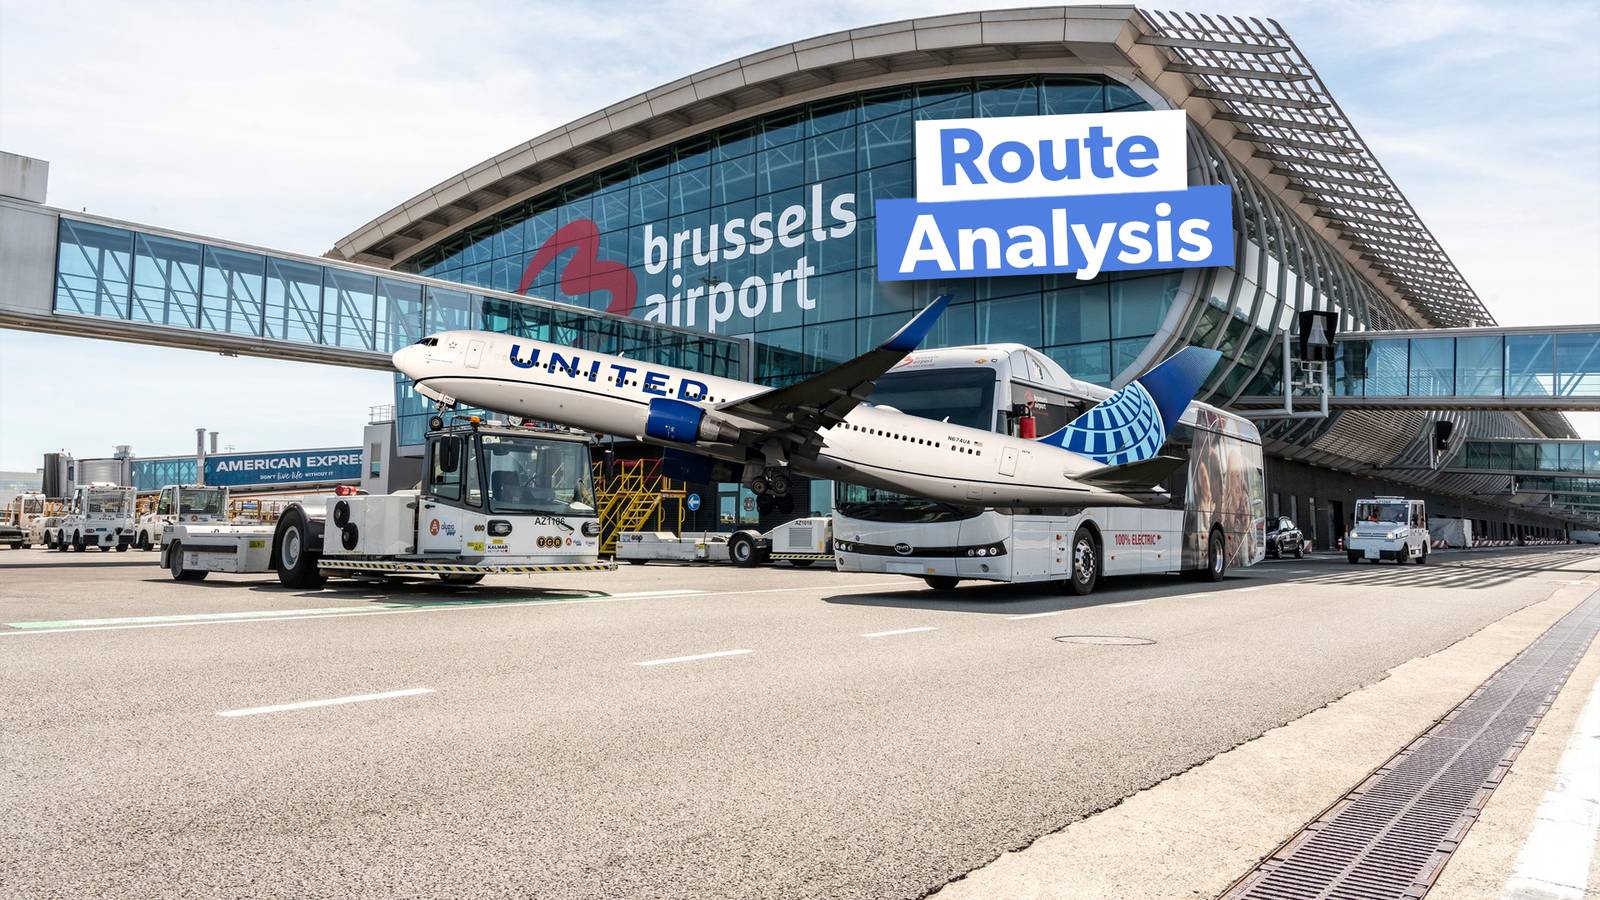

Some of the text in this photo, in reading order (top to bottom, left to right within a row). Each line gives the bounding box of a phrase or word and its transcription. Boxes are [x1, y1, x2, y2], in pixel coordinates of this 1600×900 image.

[644, 184, 857, 275] brussels
[644, 256, 816, 333] airport
[510, 345, 708, 402] UNITED
[216, 456, 301, 473] AMERICAN
[1115, 534, 1156, 545] 100% ELECTRIC
